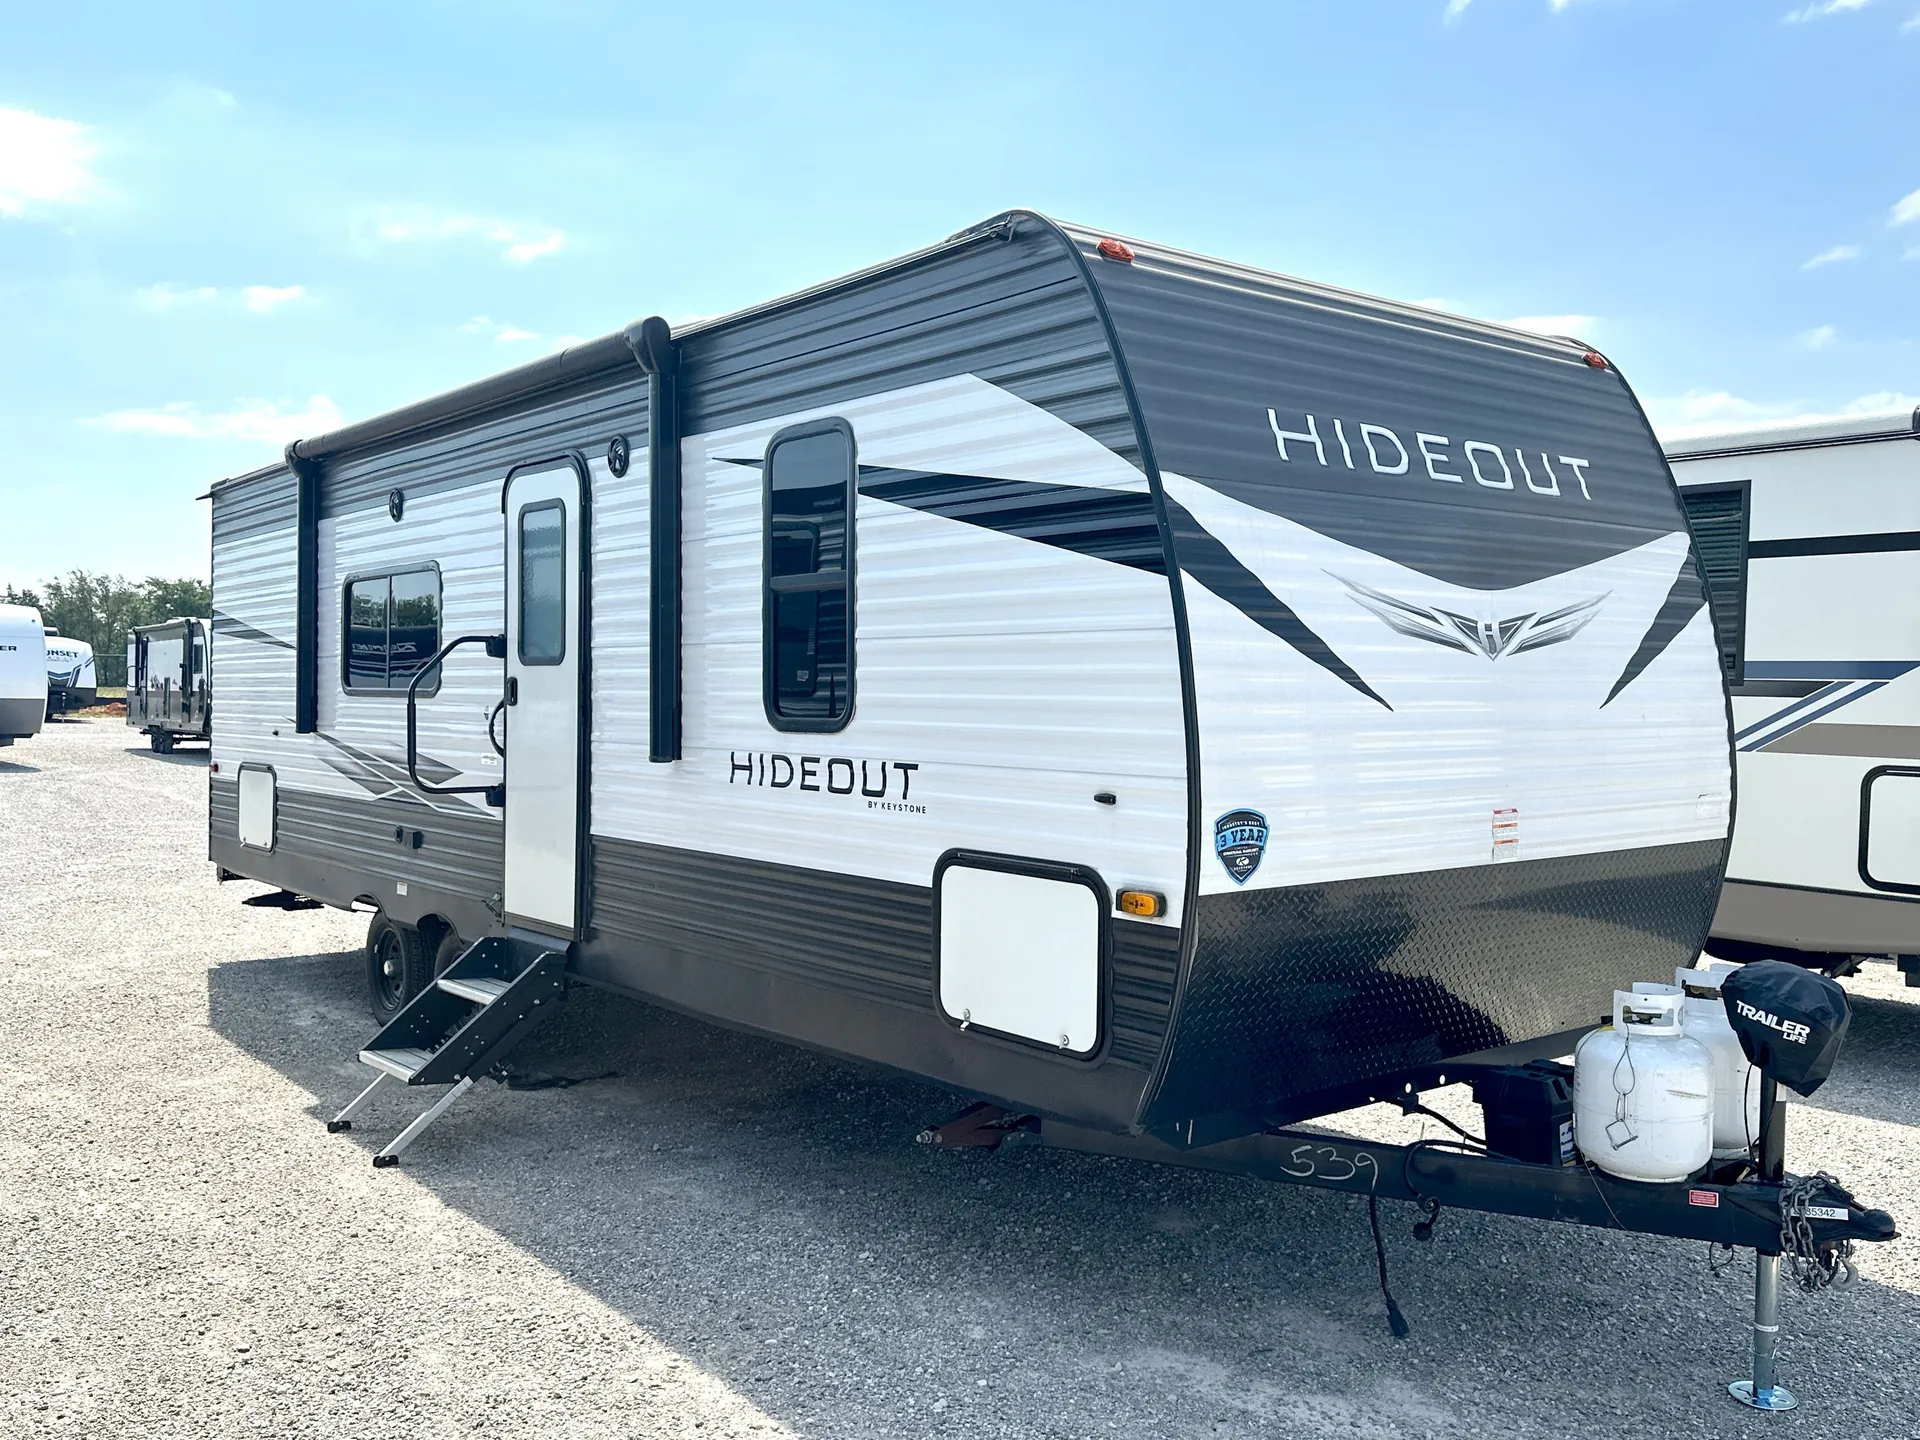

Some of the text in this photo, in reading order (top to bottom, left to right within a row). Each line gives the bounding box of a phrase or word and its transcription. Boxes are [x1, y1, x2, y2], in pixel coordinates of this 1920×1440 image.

[1266, 407, 1593, 501] HIDEOUT
[729, 751, 919, 800] HIDEOUT
[868, 800, 926, 814] BY KEYSTONE
[1220, 828, 1265, 848] 3 YEAR
[1736, 1000, 1811, 1038] TRAILER
[1782, 1032, 1808, 1045] LIFE
[1280, 1145, 1379, 1192] 539
